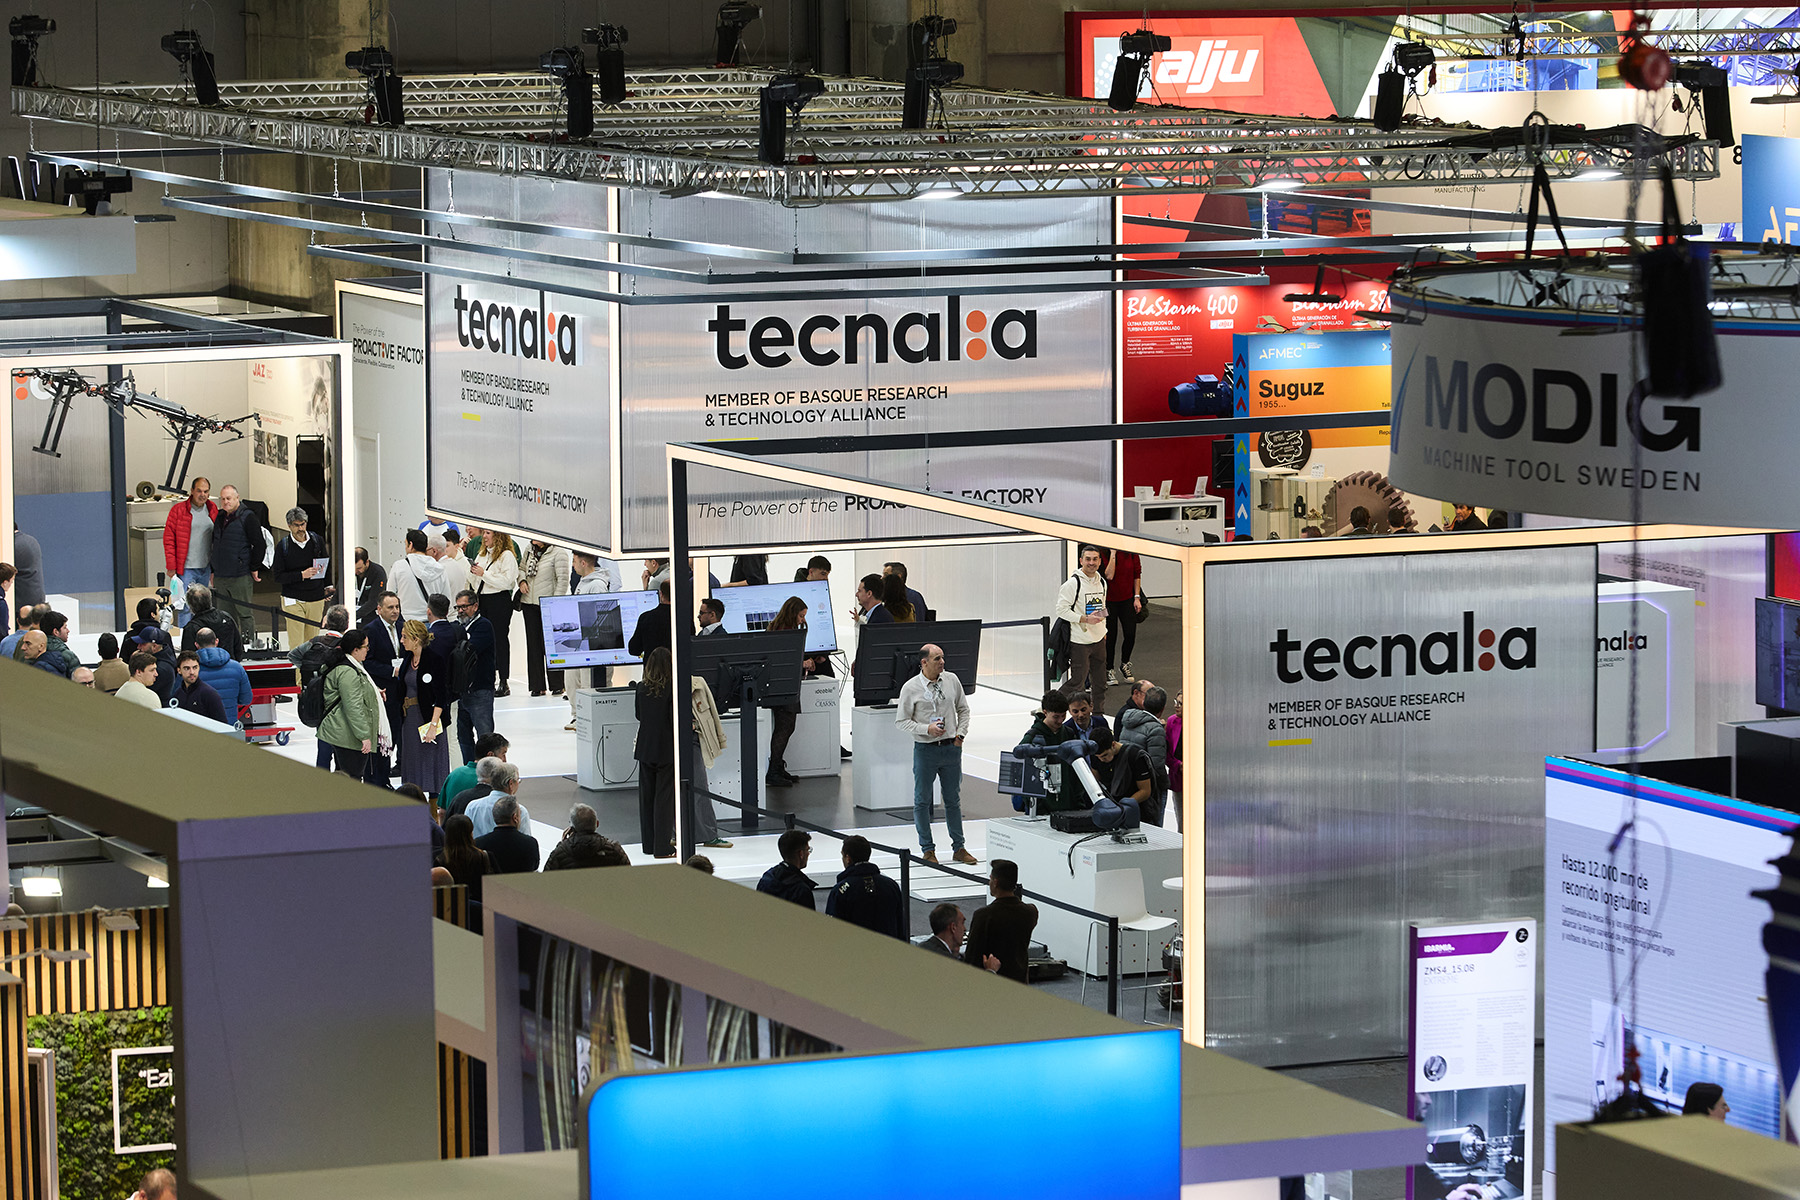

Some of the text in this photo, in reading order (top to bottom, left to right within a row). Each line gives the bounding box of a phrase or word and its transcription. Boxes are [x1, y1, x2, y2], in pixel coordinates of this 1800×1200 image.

[1156, 40, 1259, 94] alju
[1434, 185, 1486, 193] MANUFACTURING
[1127, 294, 1239, 318] BlaStorm 400
[1259, 347, 1302, 360] AFMEC
[461, 369, 550, 396] MEMBER OF BASQUE RESEARCH
[1259, 380, 1325, 401] Suguz
[461, 388, 534, 412] & TECHNOLOGY ALLIANCE
[705, 385, 948, 408] MEMBER OF BASQUE RESEARCH
[1425, 355, 1702, 452] MODIG
[705, 406, 906, 427] & TECHNOLOGY ALLIANCE
[1423, 446, 1701, 492] MACHINE TOOL SWEDEN
[456, 471, 468, 488] The
[468, 474, 489, 492] Power
[488, 479, 497, 494] of
[496, 480, 507, 496] the
[552, 491, 588, 514] FACTORY
[697, 502, 727, 519] The
[731, 500, 785, 517] Power
[788, 498, 808, 515] of
[810, 497, 838, 513] the
[1268, 691, 1466, 714] MEMBER OF BASQUE RESEARCH
[1268, 709, 1431, 731] & TECHNOLOGY ALLIANCE
[1562, 853, 1586, 875] Hasta
[1588, 860, 1619, 883] 12.000
[1637, 872, 1649, 891] de
[1562, 880, 1651, 916] recorrido longitudinal
